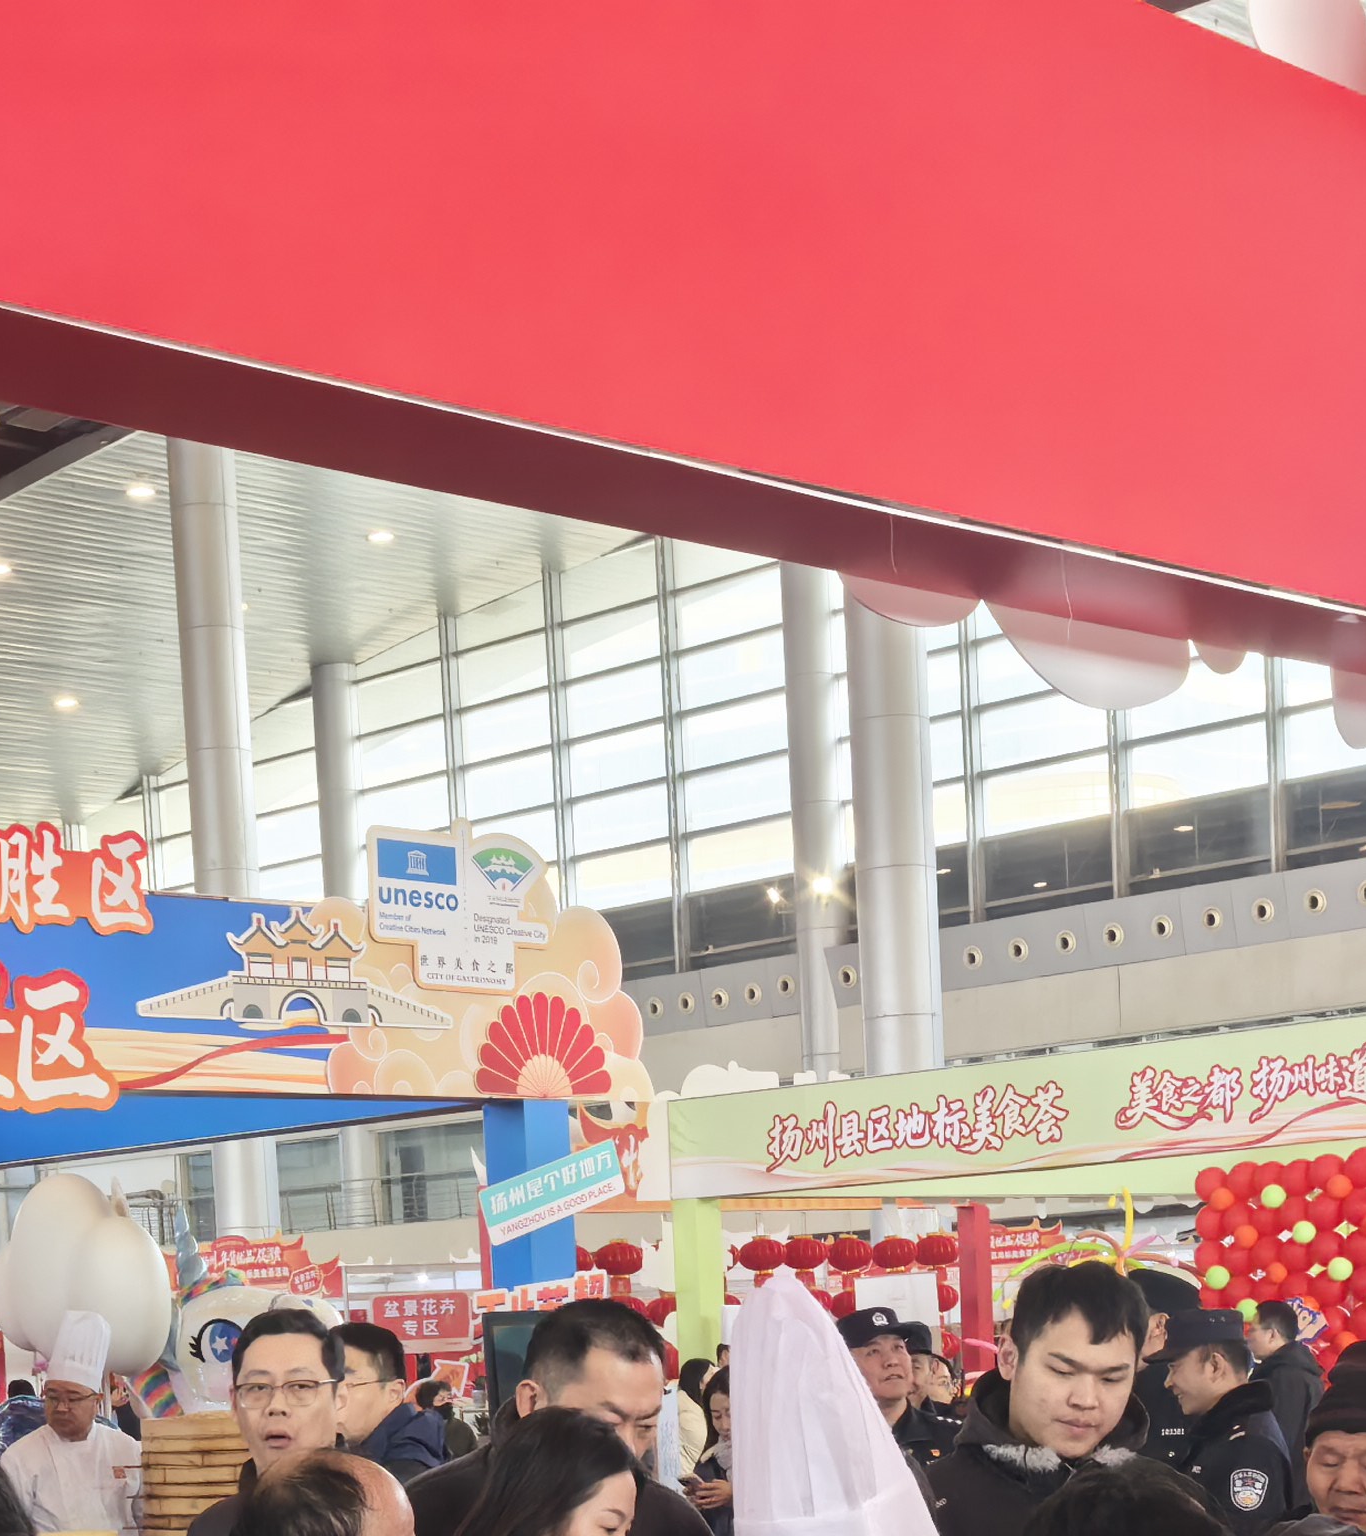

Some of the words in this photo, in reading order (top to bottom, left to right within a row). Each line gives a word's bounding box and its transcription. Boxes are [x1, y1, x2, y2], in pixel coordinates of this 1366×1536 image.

[378, 885, 459, 911] unesco
[379, 912, 403, 922] Member
[404, 913, 412, 921] of
[473, 913, 510, 925] Designated
[379, 924, 403, 933] Creative
[421, 927, 446, 936] Network
[473, 925, 504, 935] UNESCO
[506, 927, 532, 937] Creative
[533, 930, 546, 940] City
[420, 954, 513, 974] 世界美食之都
[427, 972, 444, 980] CITY
[456, 975, 507, 985] GASTRONOMY
[767, 1081, 1069, 1171] 扬州县区地标美食荟
[1116, 1064, 1242, 1130] 美食之都
[490, 1149, 613, 1216] 扬州是个好地方
[500, 1212, 546, 1236] YANGZHOU
[564, 1195, 588, 1211] GOOD
[383, 1297, 456, 1318] 盆景花卉
[402, 1319, 439, 1337] 专区
